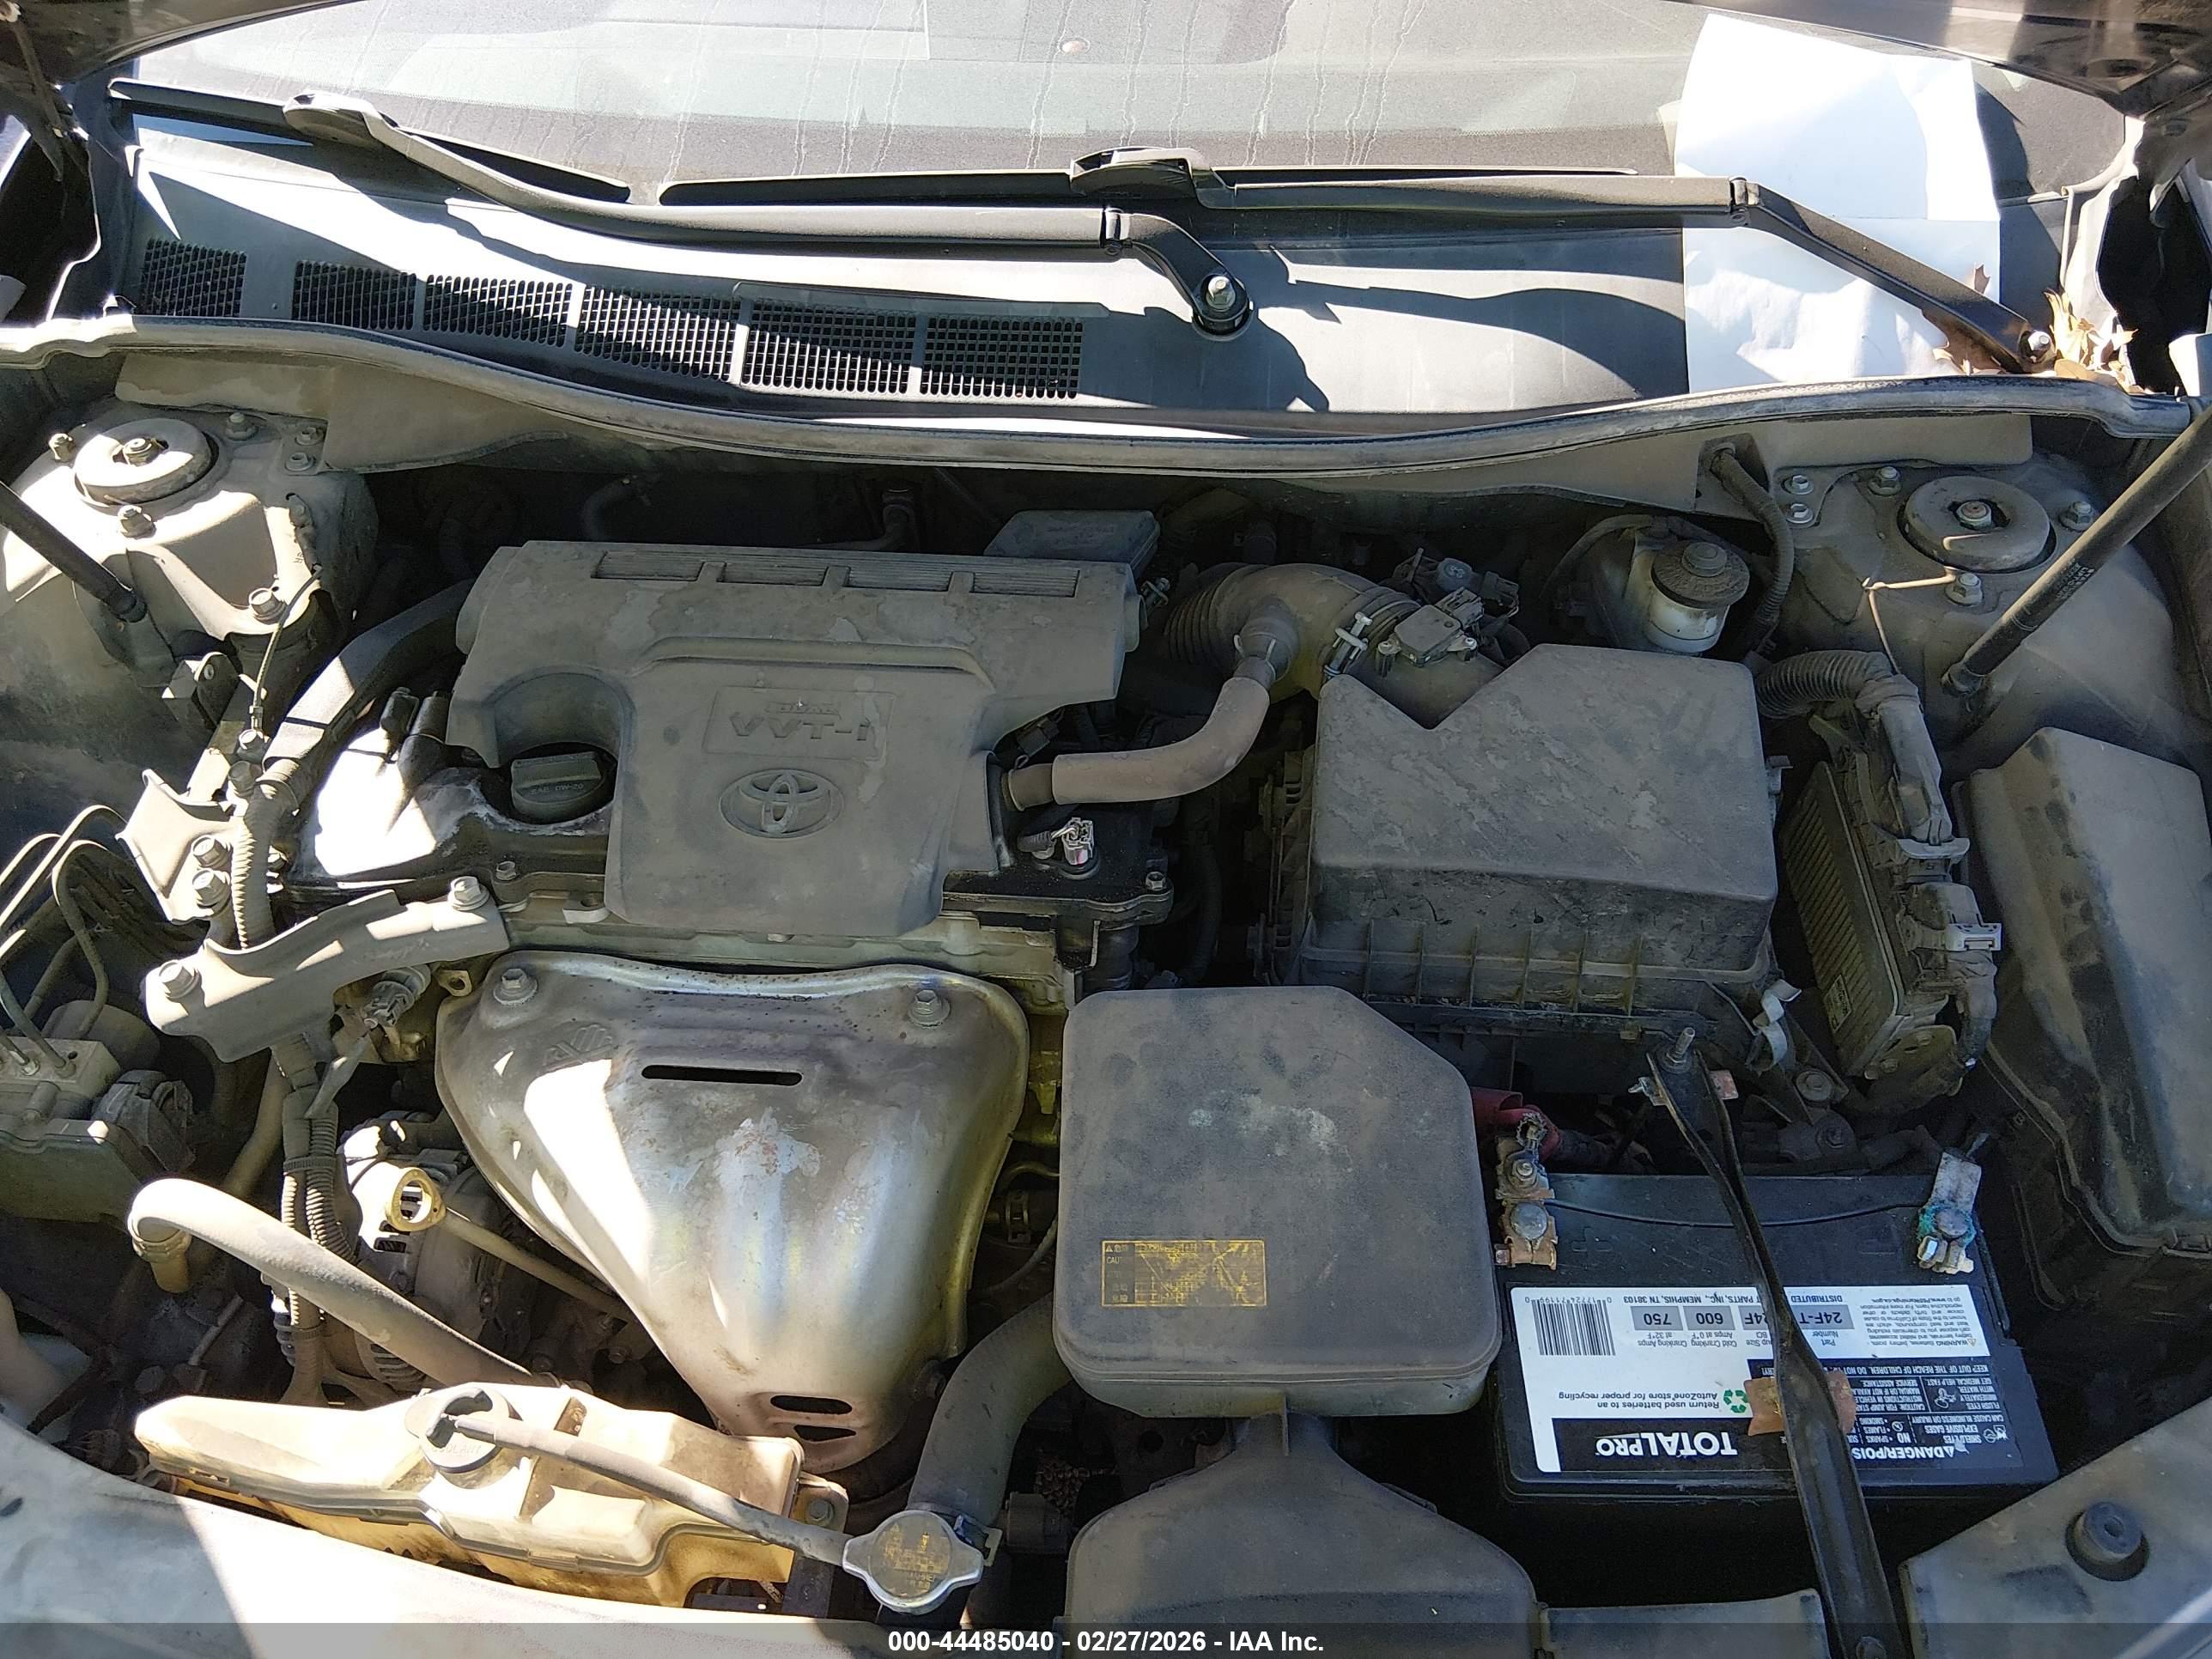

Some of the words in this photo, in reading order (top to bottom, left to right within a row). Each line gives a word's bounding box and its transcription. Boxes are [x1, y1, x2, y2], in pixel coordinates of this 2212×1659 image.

[1644, 1313, 1671, 1325] 750
[1696, 1312, 1723, 1324] 600
[1638, 1339, 1656, 1347] Amps
[1657, 1339, 1687, 1347] Cranking
[1692, 1339, 1720, 1347] Cranking
[1559, 1391, 1598, 1401] recycling
[1601, 1391, 1631, 1400] proper
[1924, 1425, 1944, 1433] GASES
[1945, 1425, 1978, 1433] EXPLOSIVE
[1897, 1432, 1911, 1443] NO
[1595, 1431, 1737, 1457] TOTALPRO
[1851, 1446, 1944, 1459] DANGER/POIS
